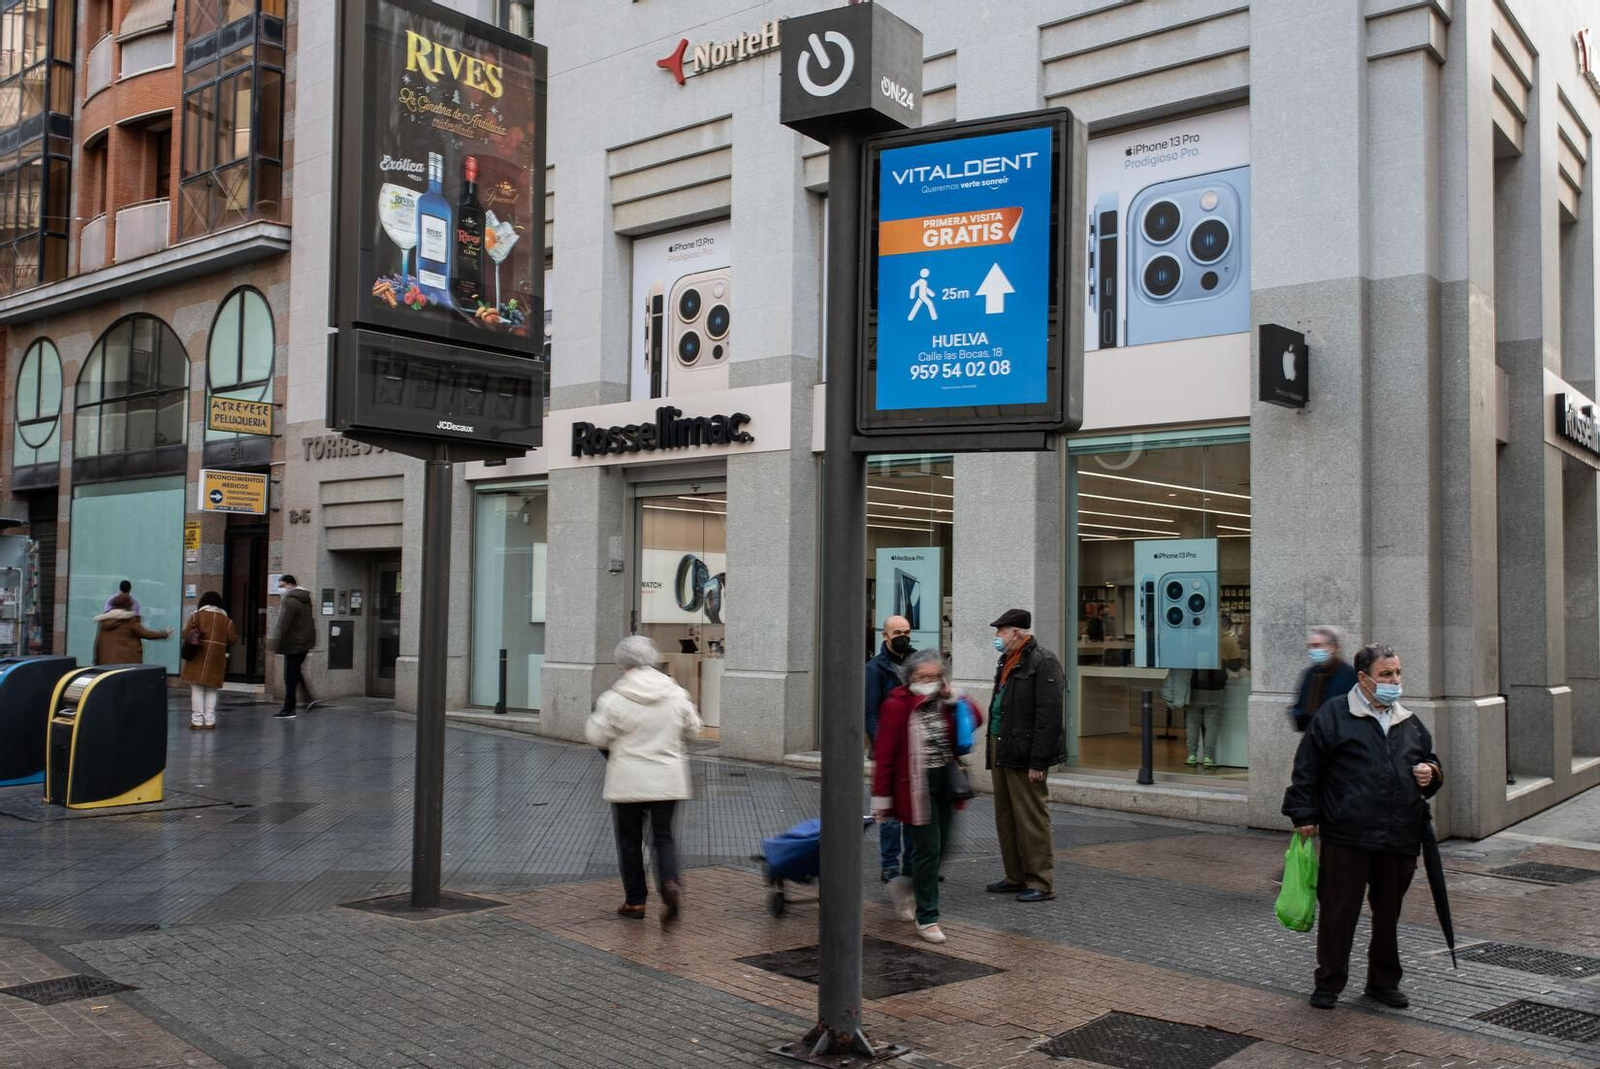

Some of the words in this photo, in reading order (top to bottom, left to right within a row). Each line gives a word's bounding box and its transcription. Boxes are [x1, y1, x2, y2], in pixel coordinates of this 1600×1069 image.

[405, 30, 503, 99] RIVES
[1133, 141, 1168, 155] iPhone
[1169, 136, 1181, 147] 13
[1182, 134, 1200, 145] Pro
[1124, 152, 1178, 170] Prodigioso
[1180, 147, 1201, 159] Pro.
[892, 151, 1039, 185] VITALDENT
[921, 183, 959, 194] Queremos
[960, 180, 981, 189] verte
[923, 216, 968, 229] PRIMERA
[969, 211, 1003, 224] VISITA
[922, 221, 1004, 248] GRATIS
[673, 241, 695, 252] iPhone
[695, 239, 703, 247] 13
[703, 237, 714, 246] Pro
[942, 287, 970, 301] 25m
[932, 331, 989, 349] HUELVA
[918, 351, 943, 363] Calle
[943, 350, 957, 361] las
[958, 348, 991, 360] Bocas,
[992, 346, 1003, 358] 18
[910, 363, 940, 381] 959
[942, 362, 962, 379] 54
[965, 361, 986, 377] 02
[988, 359, 1011, 376] 08
[212, 400, 271, 417] ATREVETE
[214, 412, 268, 428] PELUQUERIA
[436, 420, 474, 433] JCDecaux
[302, 433, 386, 462] TORRE
[206, 473, 265, 484] RECONOCIMIENTOS
